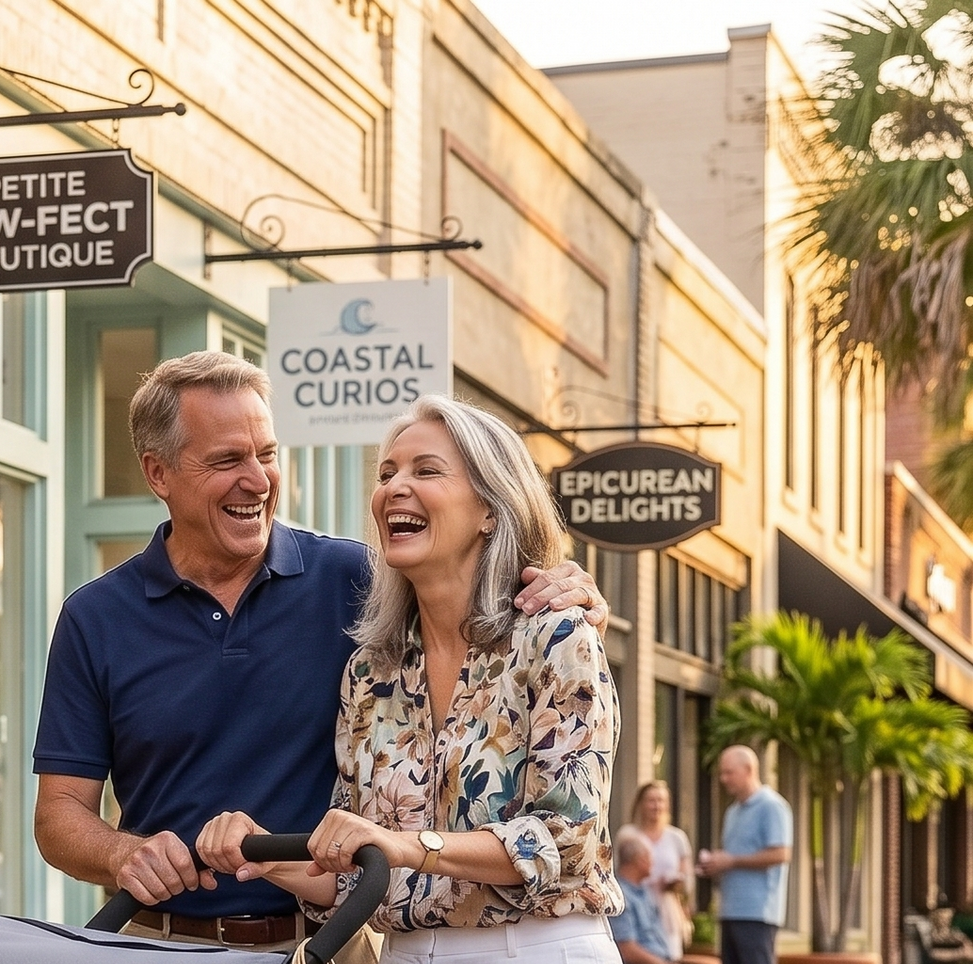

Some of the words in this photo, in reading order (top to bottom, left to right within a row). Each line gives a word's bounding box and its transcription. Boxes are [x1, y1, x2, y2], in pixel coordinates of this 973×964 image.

[281, 344, 434, 375] COASTAL
[295, 377, 420, 408] CURIOS
[559, 467, 714, 497] EPICUREAN
[570, 495, 703, 524] DELIGHTS
